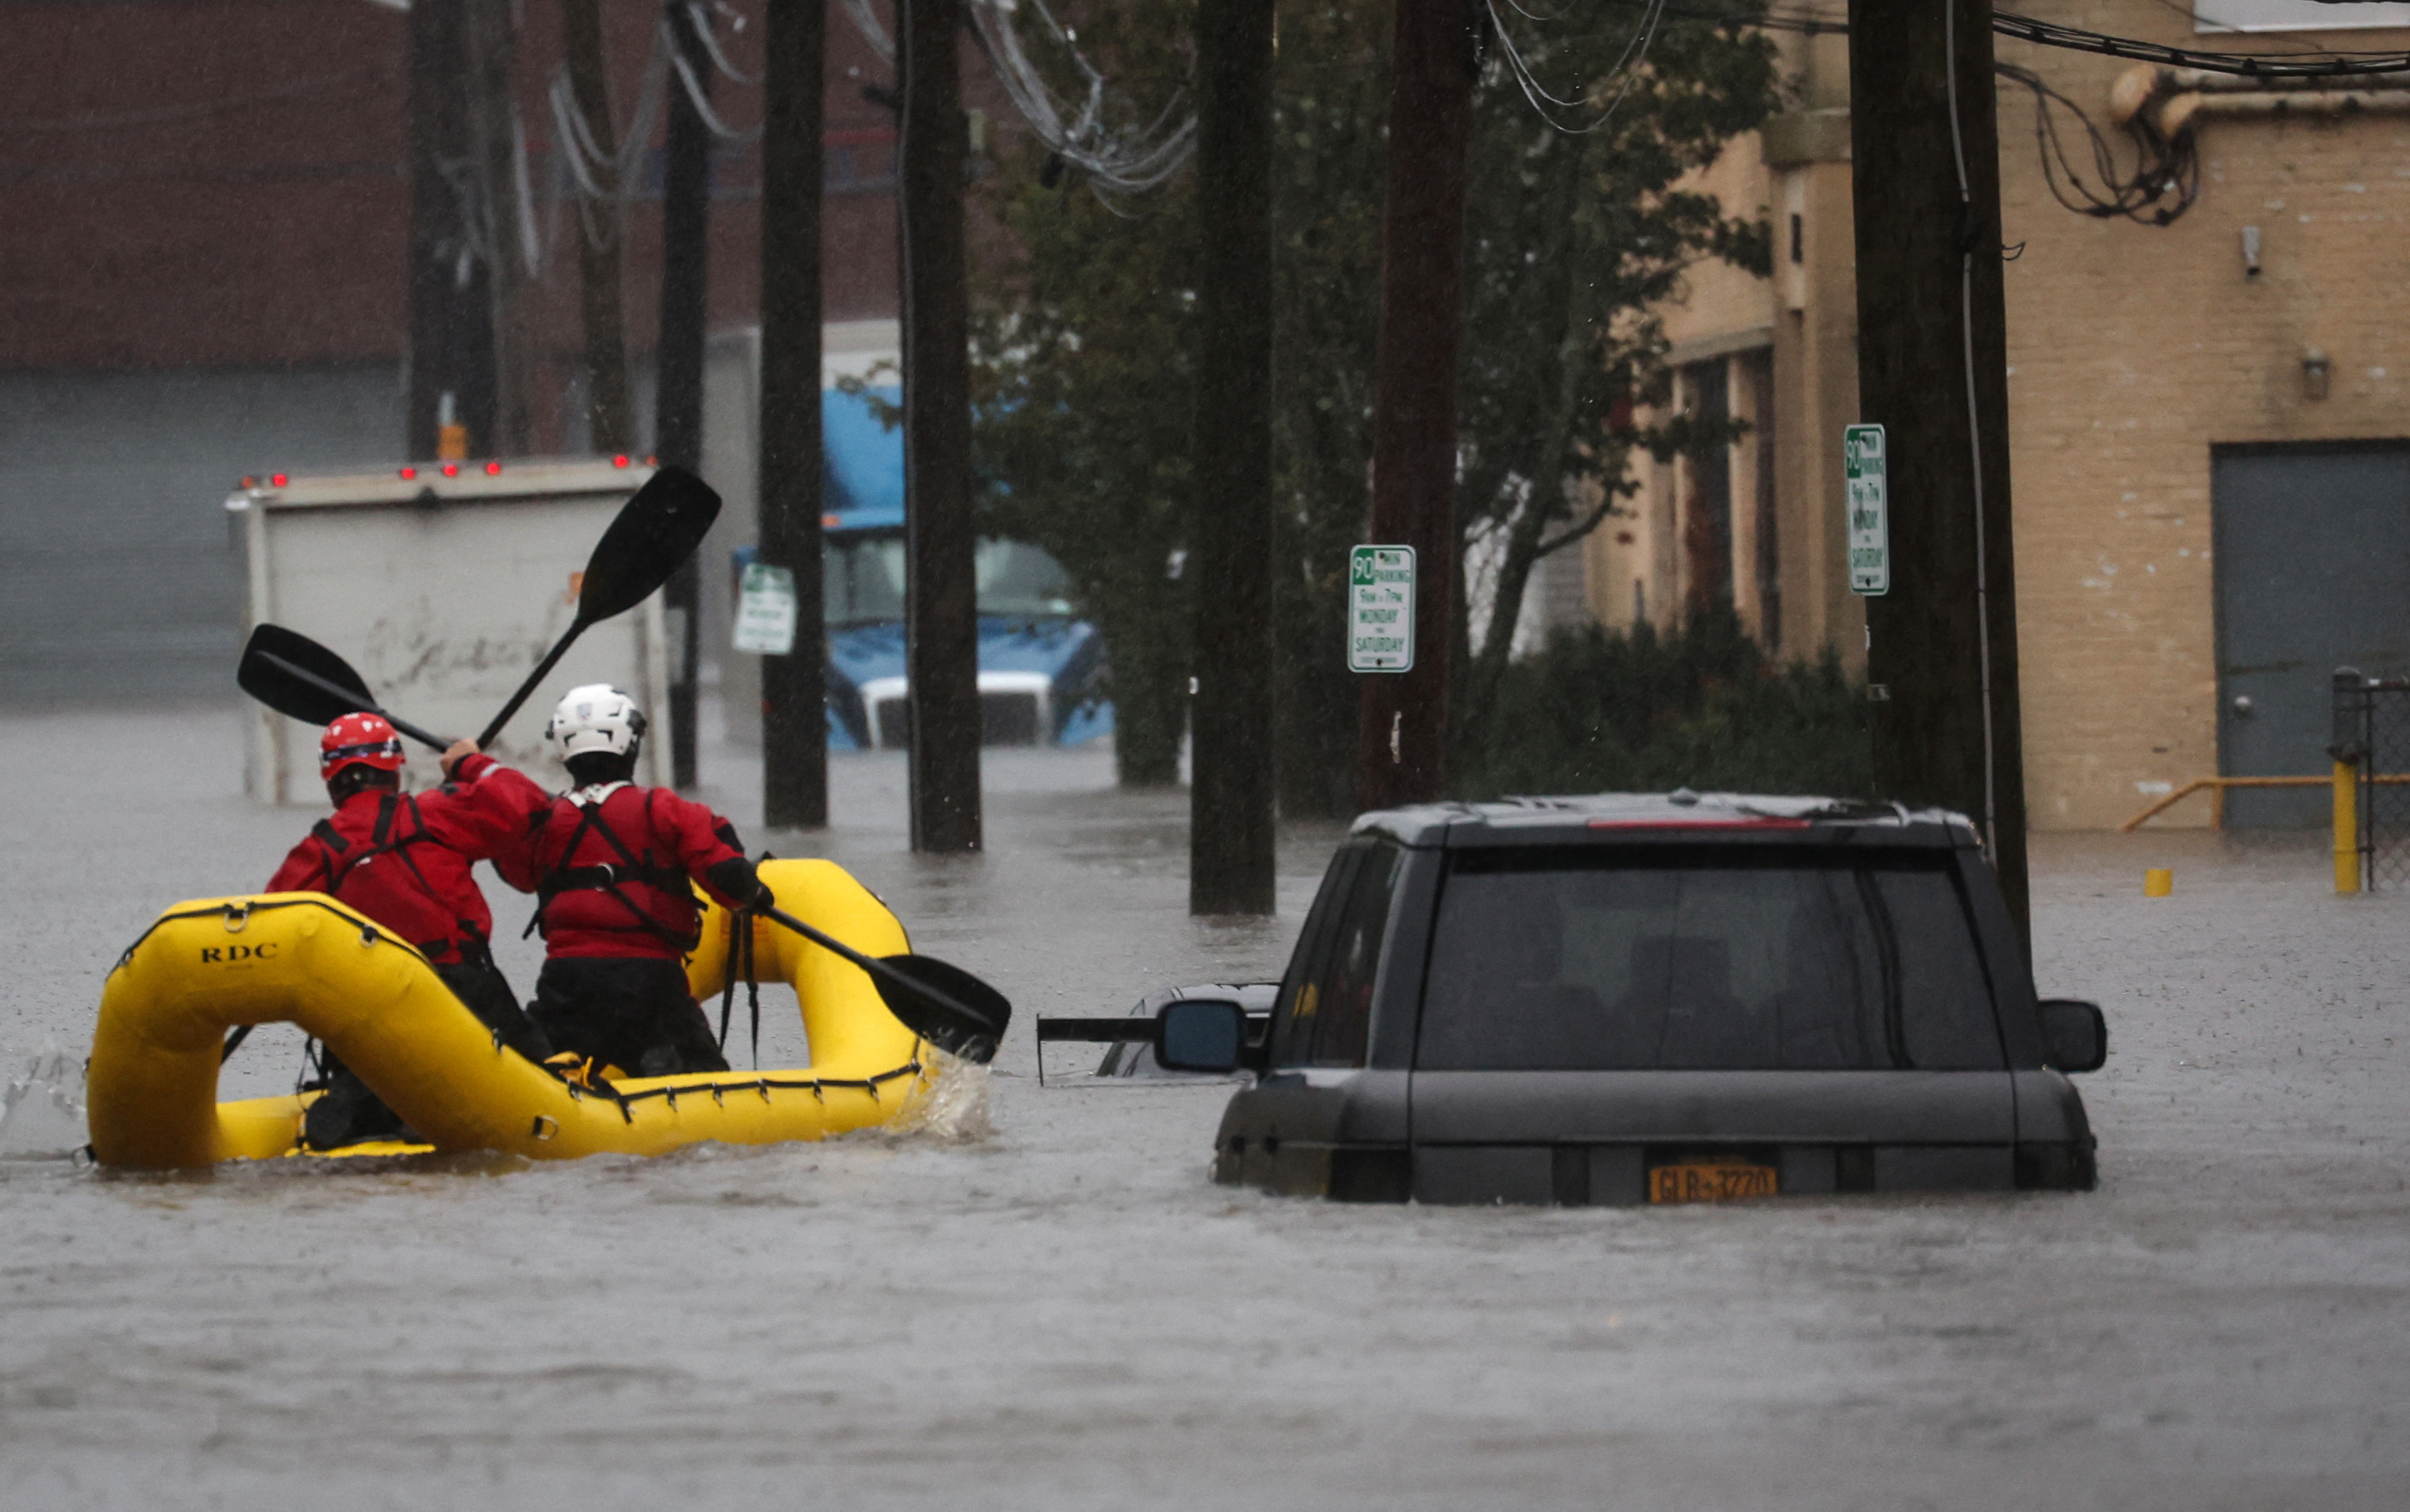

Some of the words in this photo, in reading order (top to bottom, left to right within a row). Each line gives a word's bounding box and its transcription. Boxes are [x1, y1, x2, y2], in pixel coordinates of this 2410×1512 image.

[1353, 556, 1374, 579] 90
[1359, 608, 1399, 623] MONDAY
[1355, 636, 1405, 653] SATURDAY
[202, 942, 279, 963] RDC
